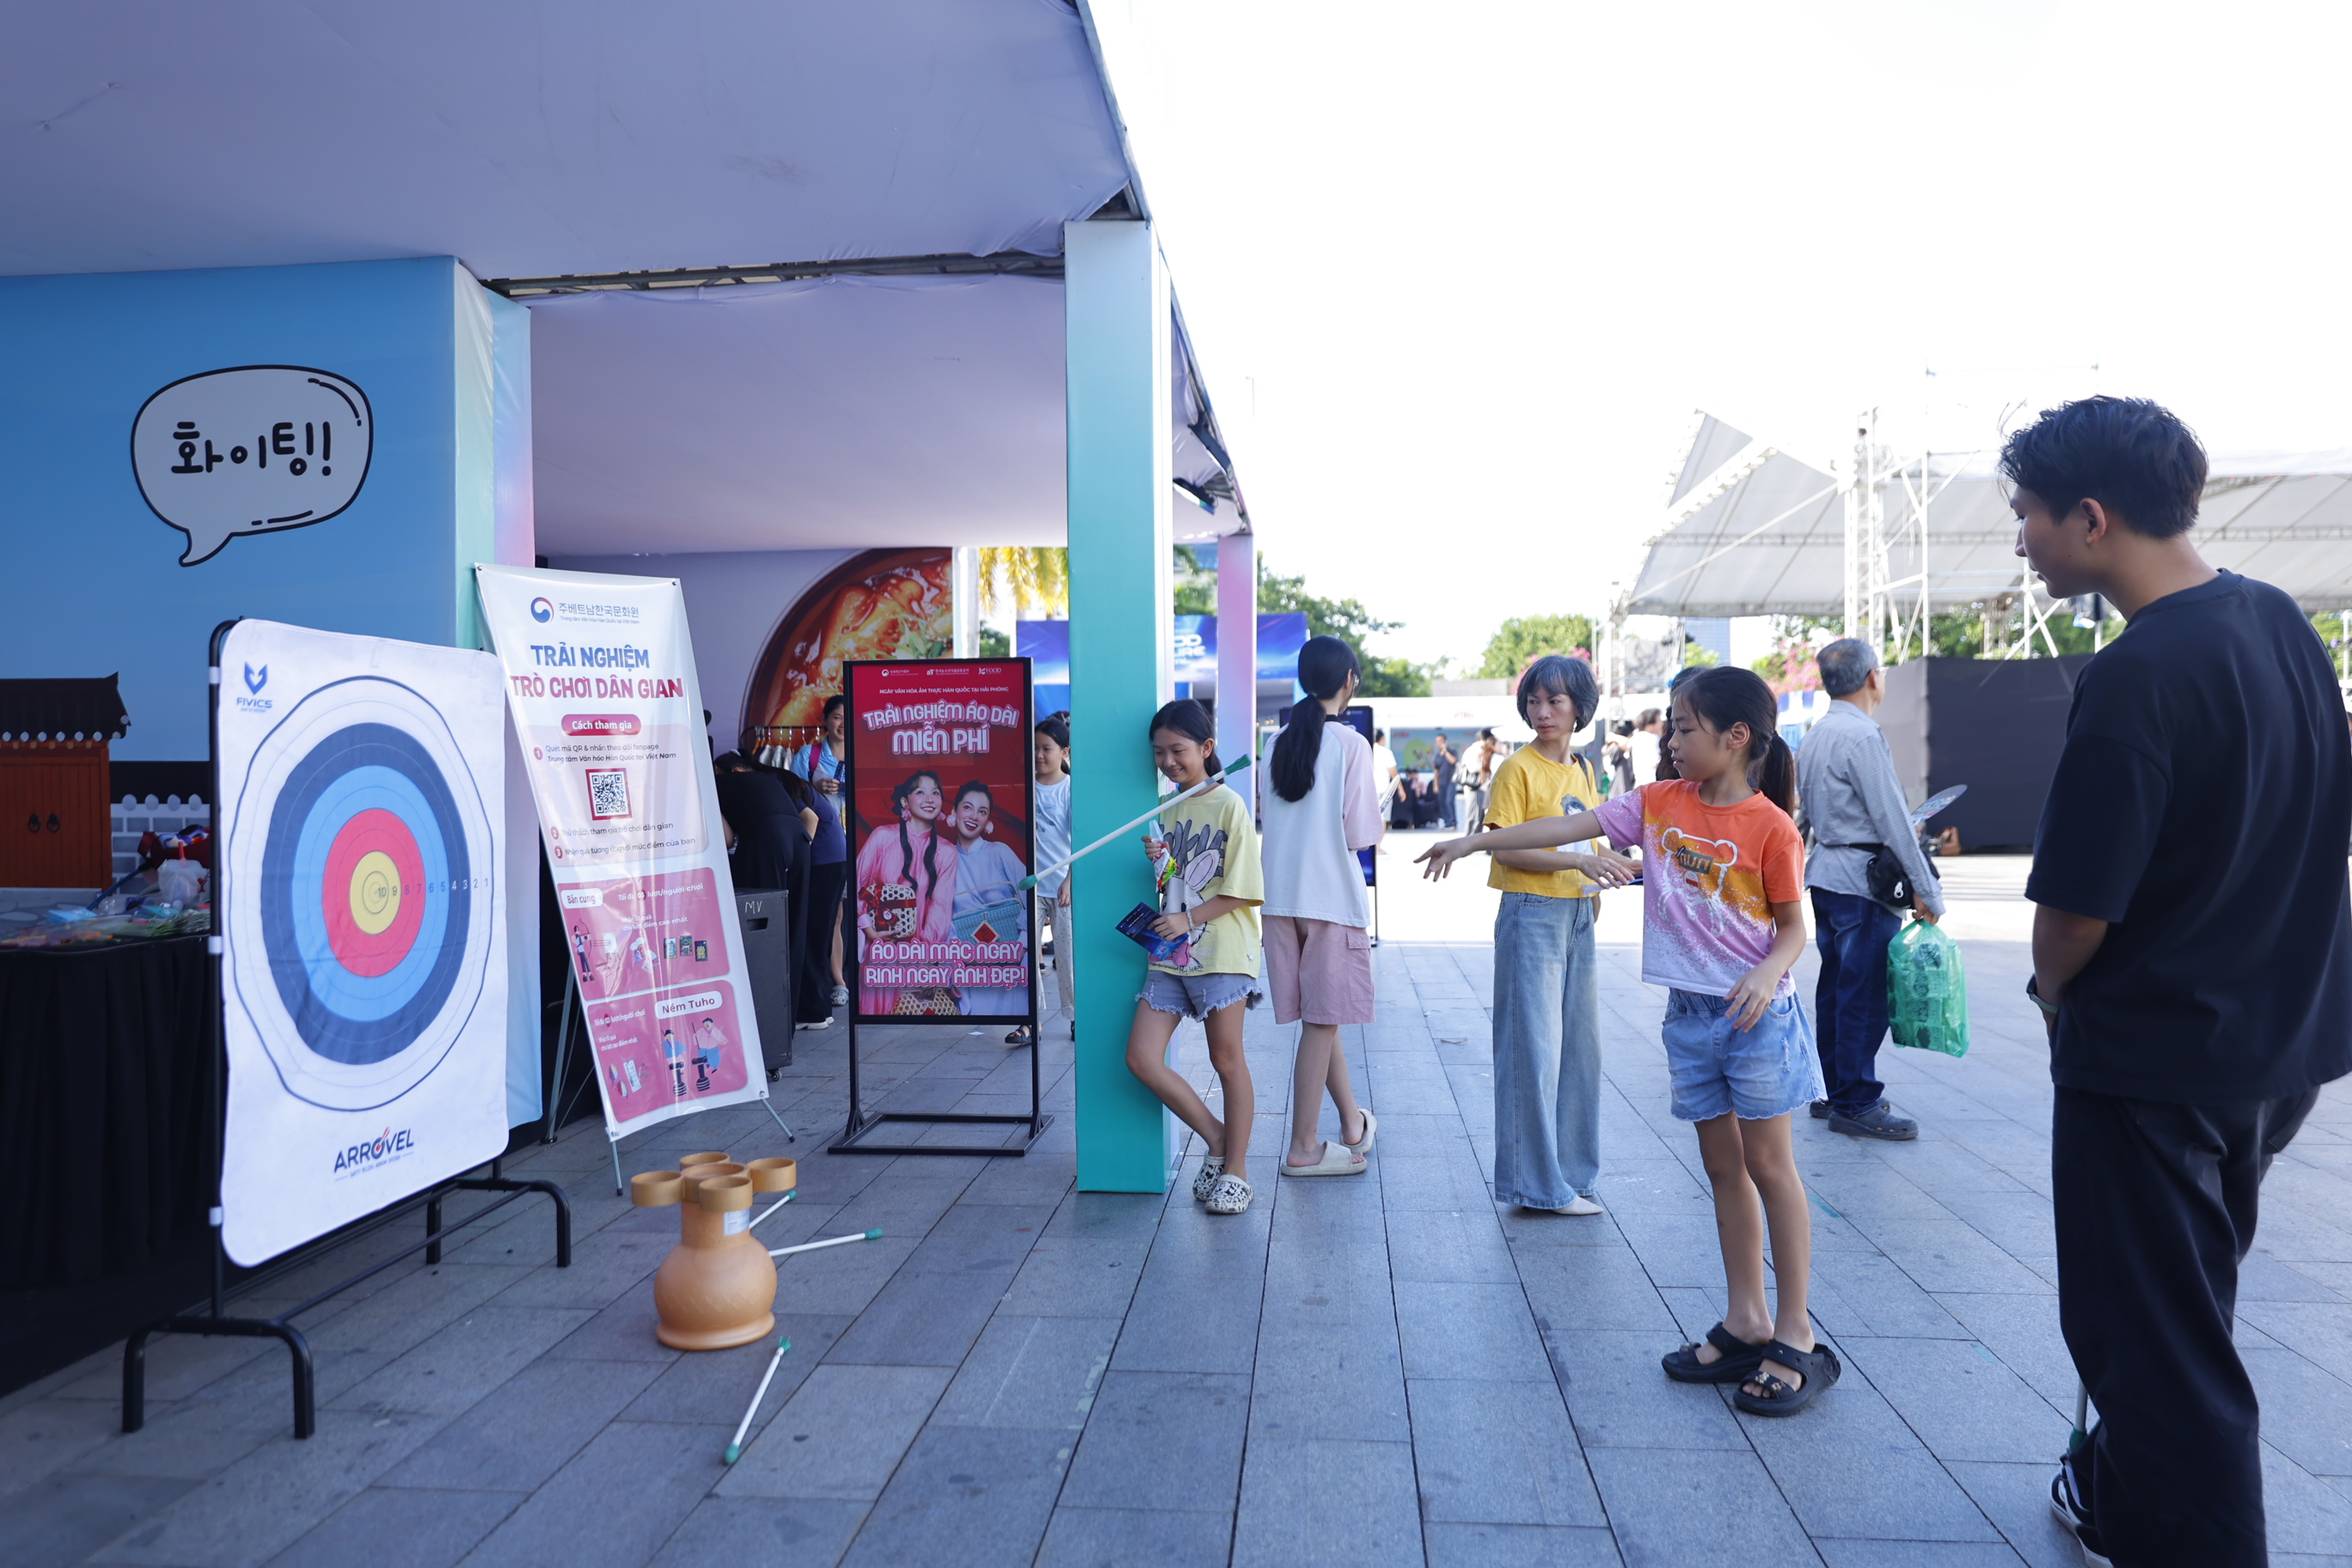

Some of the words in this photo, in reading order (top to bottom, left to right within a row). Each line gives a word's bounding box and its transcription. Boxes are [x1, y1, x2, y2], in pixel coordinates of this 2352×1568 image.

[171, 421, 332, 477] 화이팅!
[559, 603, 639, 617] 주베트남한국문화원
[530, 641, 576, 666] TRẢI
[580, 645, 650, 672] NGHIỆM
[510, 672, 545, 697] TRÒ
[549, 676, 592, 698] CHƠI
[596, 674, 634, 699] DÂN
[638, 678, 683, 698] GIAN
[236, 697, 273, 709] FIVICS
[863, 703, 901, 730] TRẢI
[903, 699, 965, 725] NGHIỆM
[966, 700, 989, 722] ÁO
[990, 704, 1020, 728] DÀI
[572, 720, 593, 730] Cách
[594, 720, 618, 730] tham
[619, 720, 633, 732] gia
[892, 721, 949, 755] MIỄN
[952, 723, 990, 753] PHÍ
[608, 826, 617, 835] gia
[657, 822, 673, 830] gian
[681, 837, 696, 846] bạn
[377, 886, 387, 897] 10
[392, 885, 398, 896] 9
[404, 884, 410, 895] 8
[417, 883, 422, 894] 7
[429, 882, 434, 893] 6
[440, 881, 445, 891] 5
[451, 879, 457, 890] 4
[462, 879, 469, 890] 3
[474, 878, 479, 889] 2
[484, 877, 488, 887] 1
[686, 883, 703, 891] chơi
[567, 894, 579, 903] Bắn
[579, 895, 596, 904] cung
[744, 900, 763, 914] MV
[671, 916, 688, 924] nhất
[871, 939, 896, 962] ÁO
[898, 940, 927, 962] DÀI
[929, 939, 973, 964] MẶC
[976, 941, 1022, 962] NGAY
[865, 966, 903, 986] RINH
[906, 966, 951, 986] NGAY
[953, 963, 989, 986] ẢNH
[990, 966, 1027, 989] ĐẸP!
[662, 1002, 686, 1014] Ném
[689, 996, 715, 1009] Tuho
[334, 1127, 414, 1173] ARROVEL
